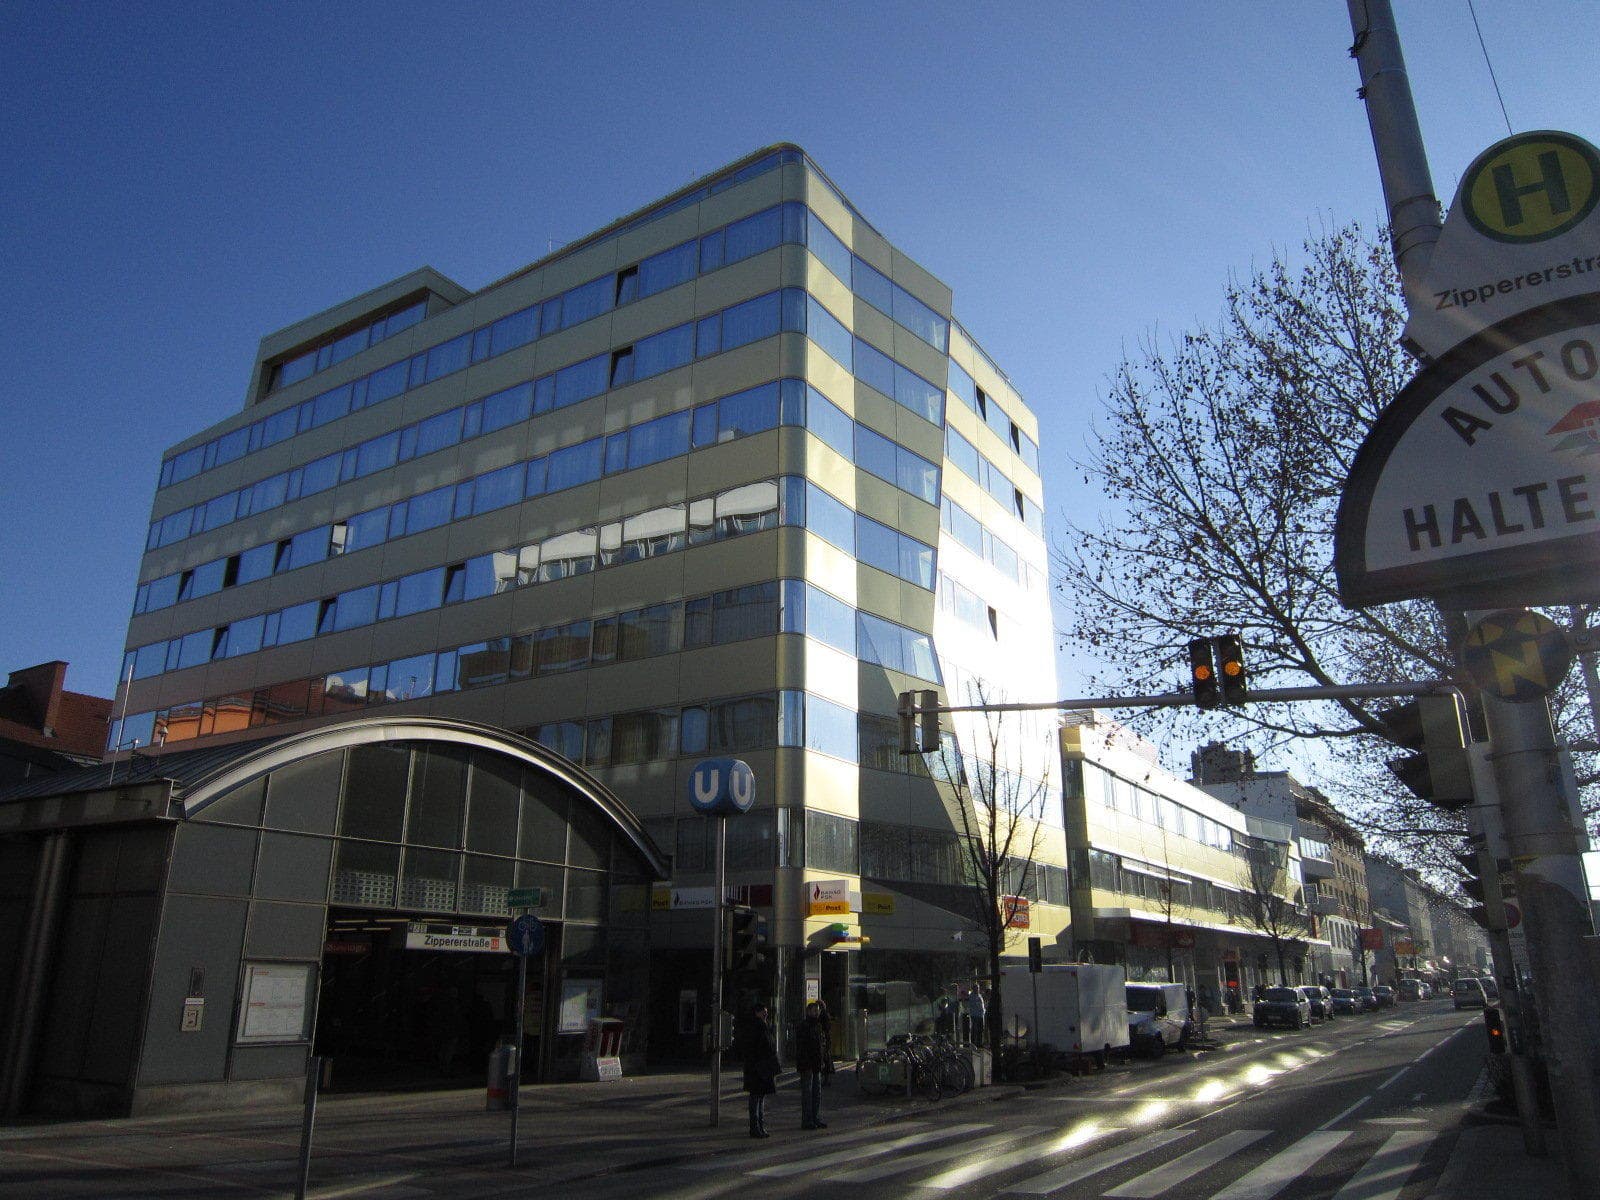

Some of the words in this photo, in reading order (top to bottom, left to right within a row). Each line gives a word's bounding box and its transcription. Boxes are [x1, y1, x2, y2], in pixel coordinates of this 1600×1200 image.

[1491, 150, 1571, 228] H
[1433, 254, 1600, 311] Zippererstr
[1402, 474, 1596, 552] HALTE
[825, 904, 842, 912] Post
[877, 903, 891, 911] Post
[424, 935, 490, 948] Zippererstraße
